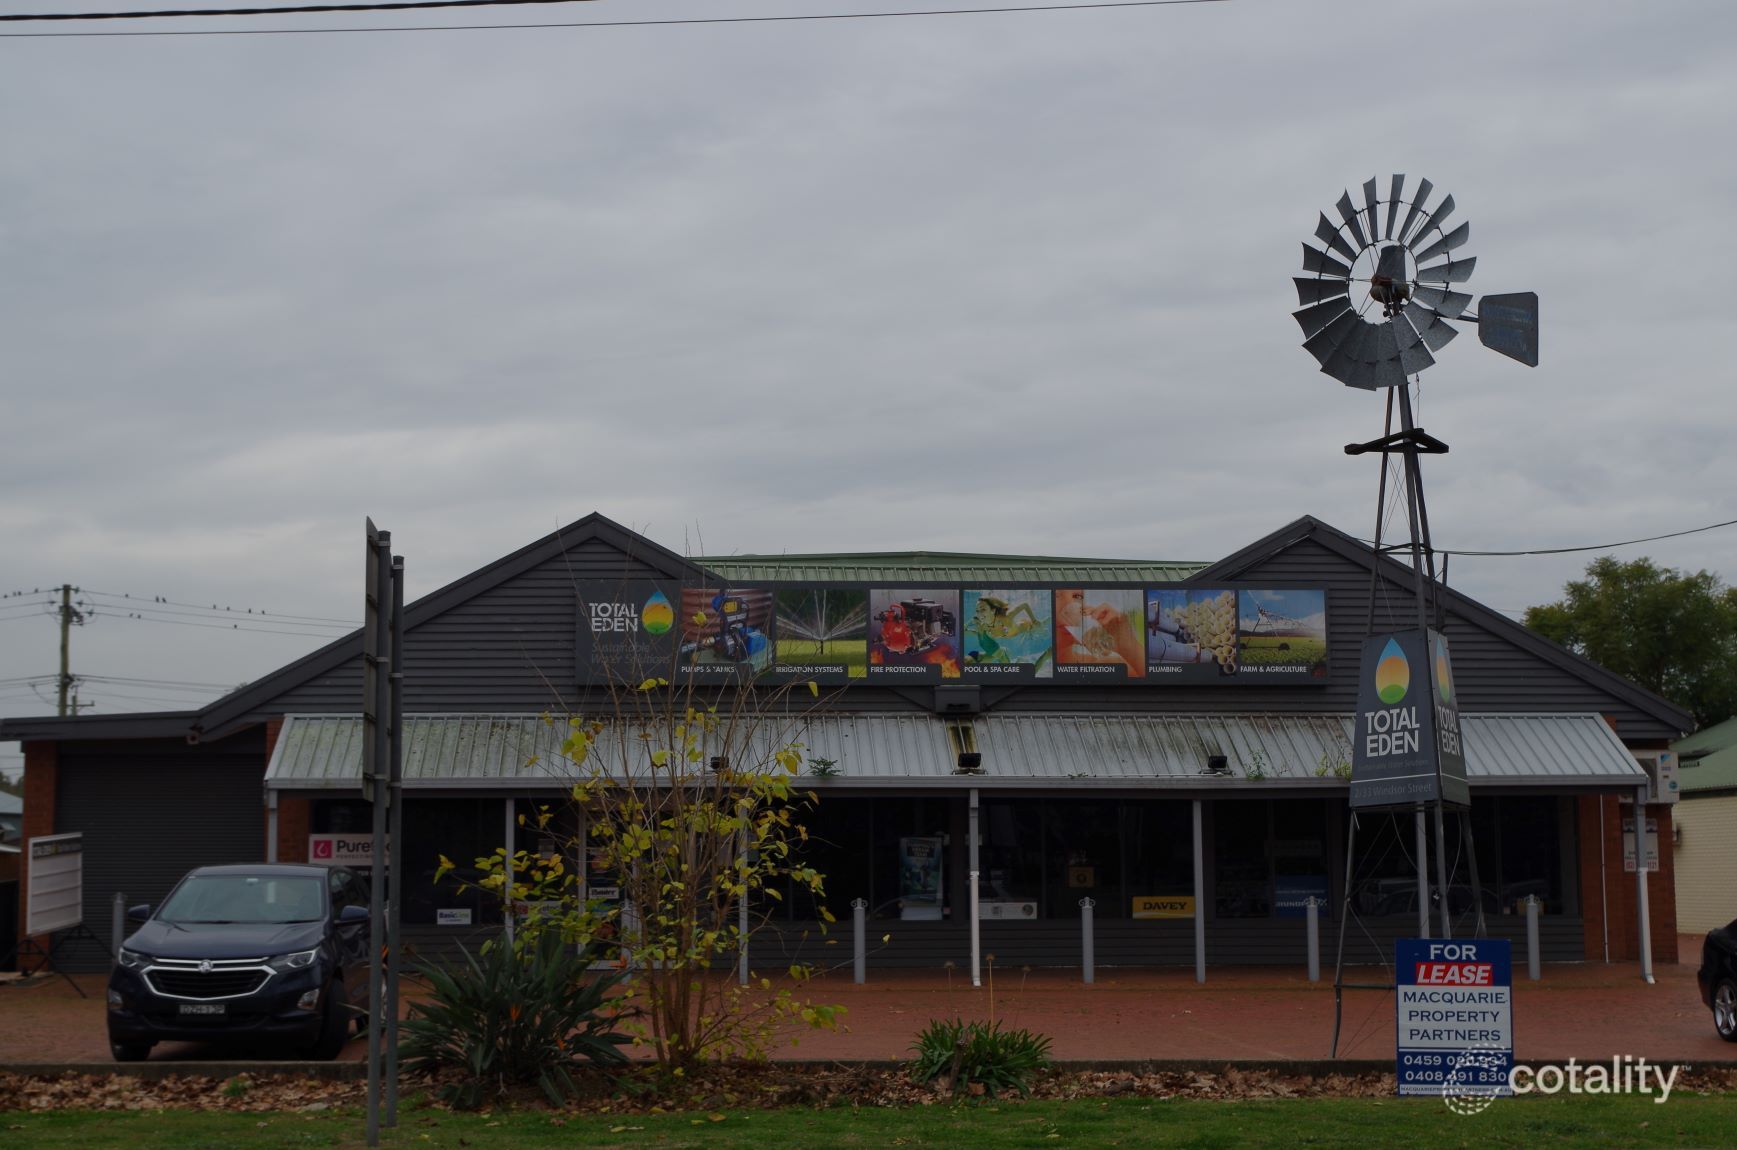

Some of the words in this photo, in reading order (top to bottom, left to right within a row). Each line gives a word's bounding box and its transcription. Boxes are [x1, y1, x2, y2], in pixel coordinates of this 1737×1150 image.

[589, 603, 638, 617] TOTAL
[591, 618, 638, 632] EDEN
[1365, 706, 1420, 734] TOTAL
[1437, 705, 1459, 733] TOTAL
[1366, 730, 1420, 757] EDEN
[1441, 729, 1461, 757] EDEN
[1407, 781, 1432, 793] Street
[1143, 902, 1187, 910] DAVEY
[1430, 944, 1477, 960] FOR
[1417, 965, 1492, 984] LEASE
[1403, 991, 1506, 1004] MACQUARIE
[1408, 1010, 1500, 1022] PROPERTY
[1409, 1029, 1501, 1041] PARTNERS
[1403, 1055, 1442, 1066] 0459
[1405, 1071, 1443, 1081] 0408
[1479, 1071, 1507, 1082] 830
